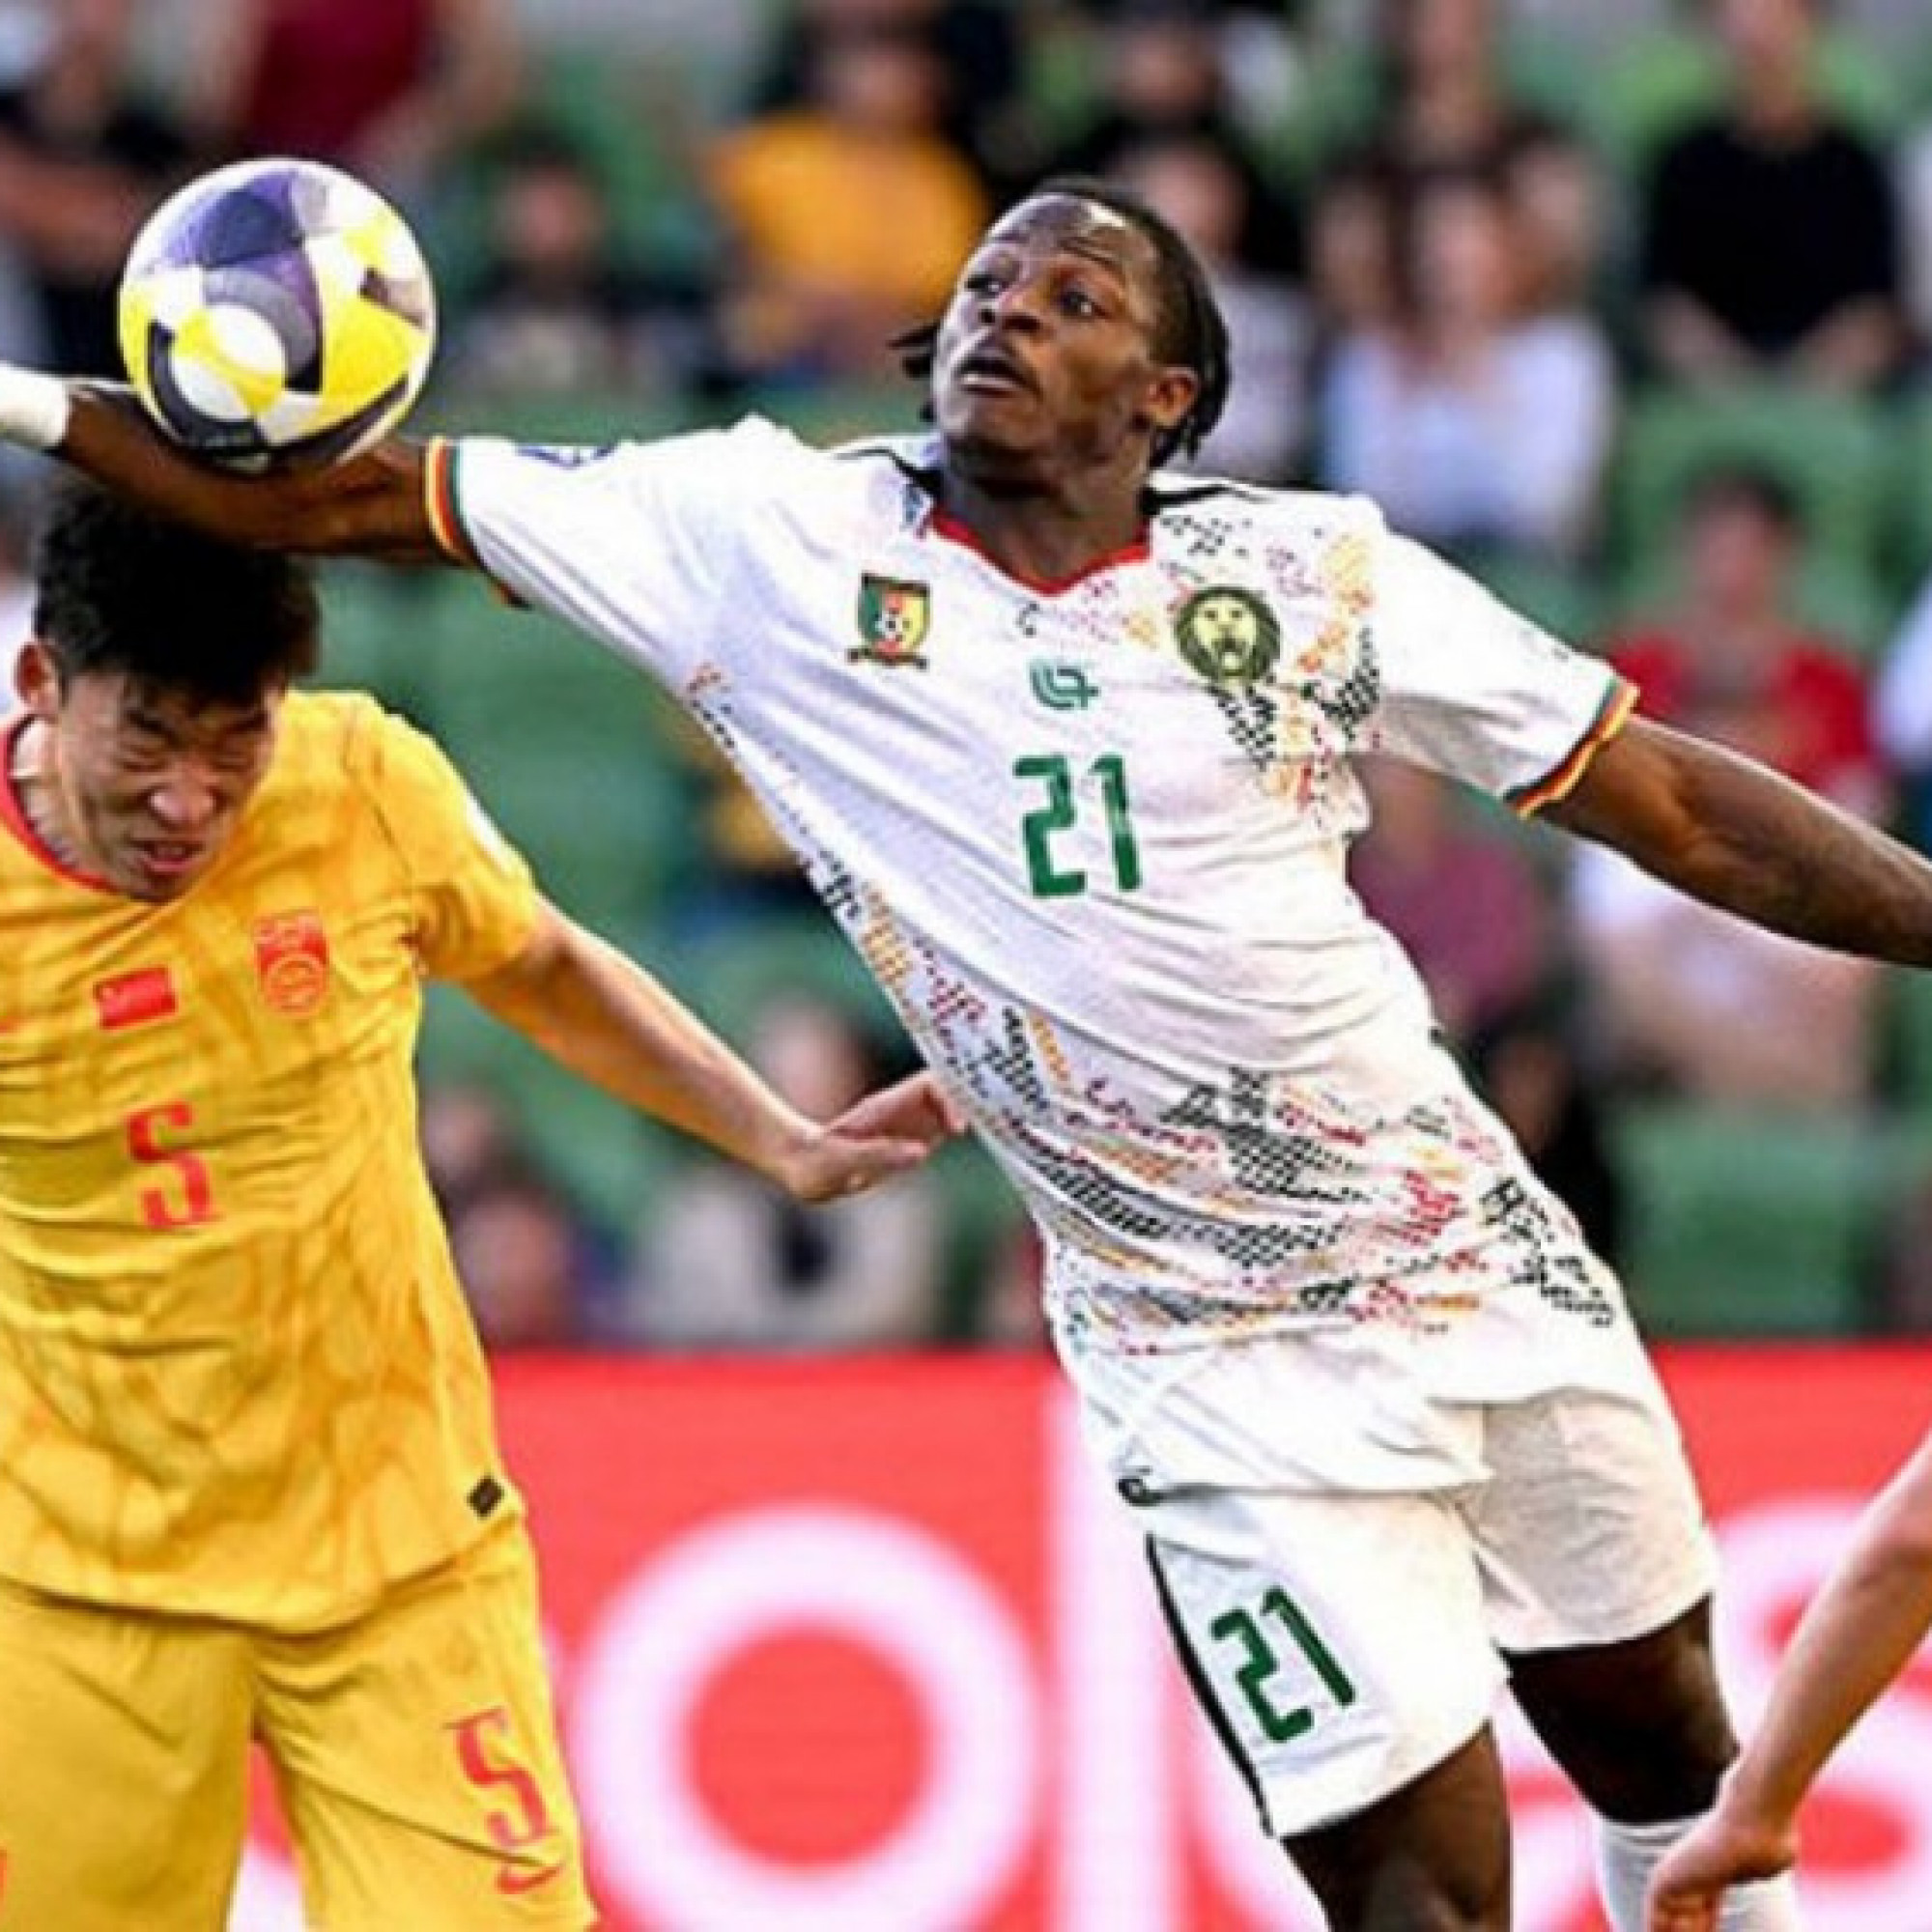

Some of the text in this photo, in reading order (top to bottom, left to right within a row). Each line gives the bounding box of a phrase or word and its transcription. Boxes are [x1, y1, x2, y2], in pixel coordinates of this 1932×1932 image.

[1012, 754, 1141, 897] 21
[126, 1100, 214, 1232] 5
[1211, 1585, 1355, 1743] 21
[444, 1706, 560, 1847] 5
